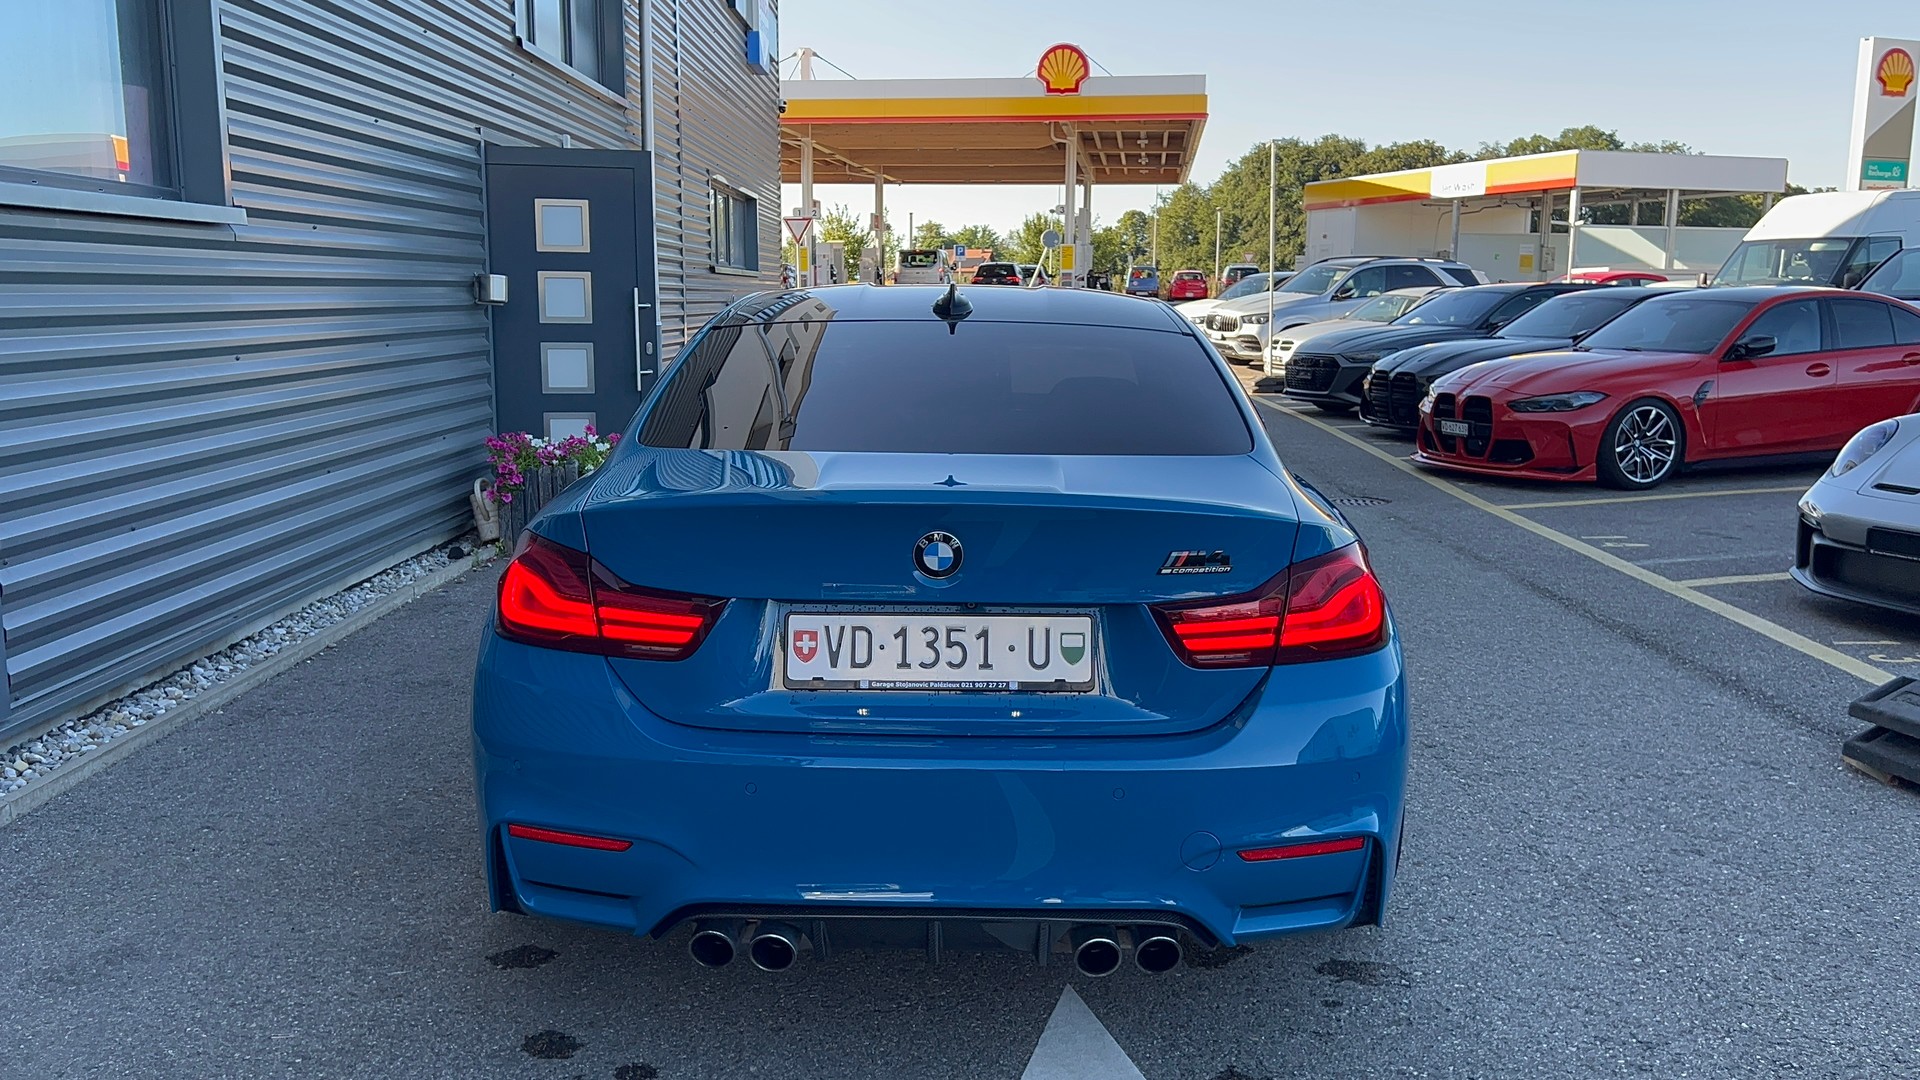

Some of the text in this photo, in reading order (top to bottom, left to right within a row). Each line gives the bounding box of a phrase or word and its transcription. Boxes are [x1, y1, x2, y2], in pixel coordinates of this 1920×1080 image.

[811, 209, 817, 217] 2
[1060, 206, 1065, 214] 3
[918, 533, 960, 549] BMW
[1171, 566, 1231, 574] competition
[871, 681, 895, 689] Garage
[895, 681, 929, 689] Stojanovic
[929, 681, 960, 689] Palézieux
